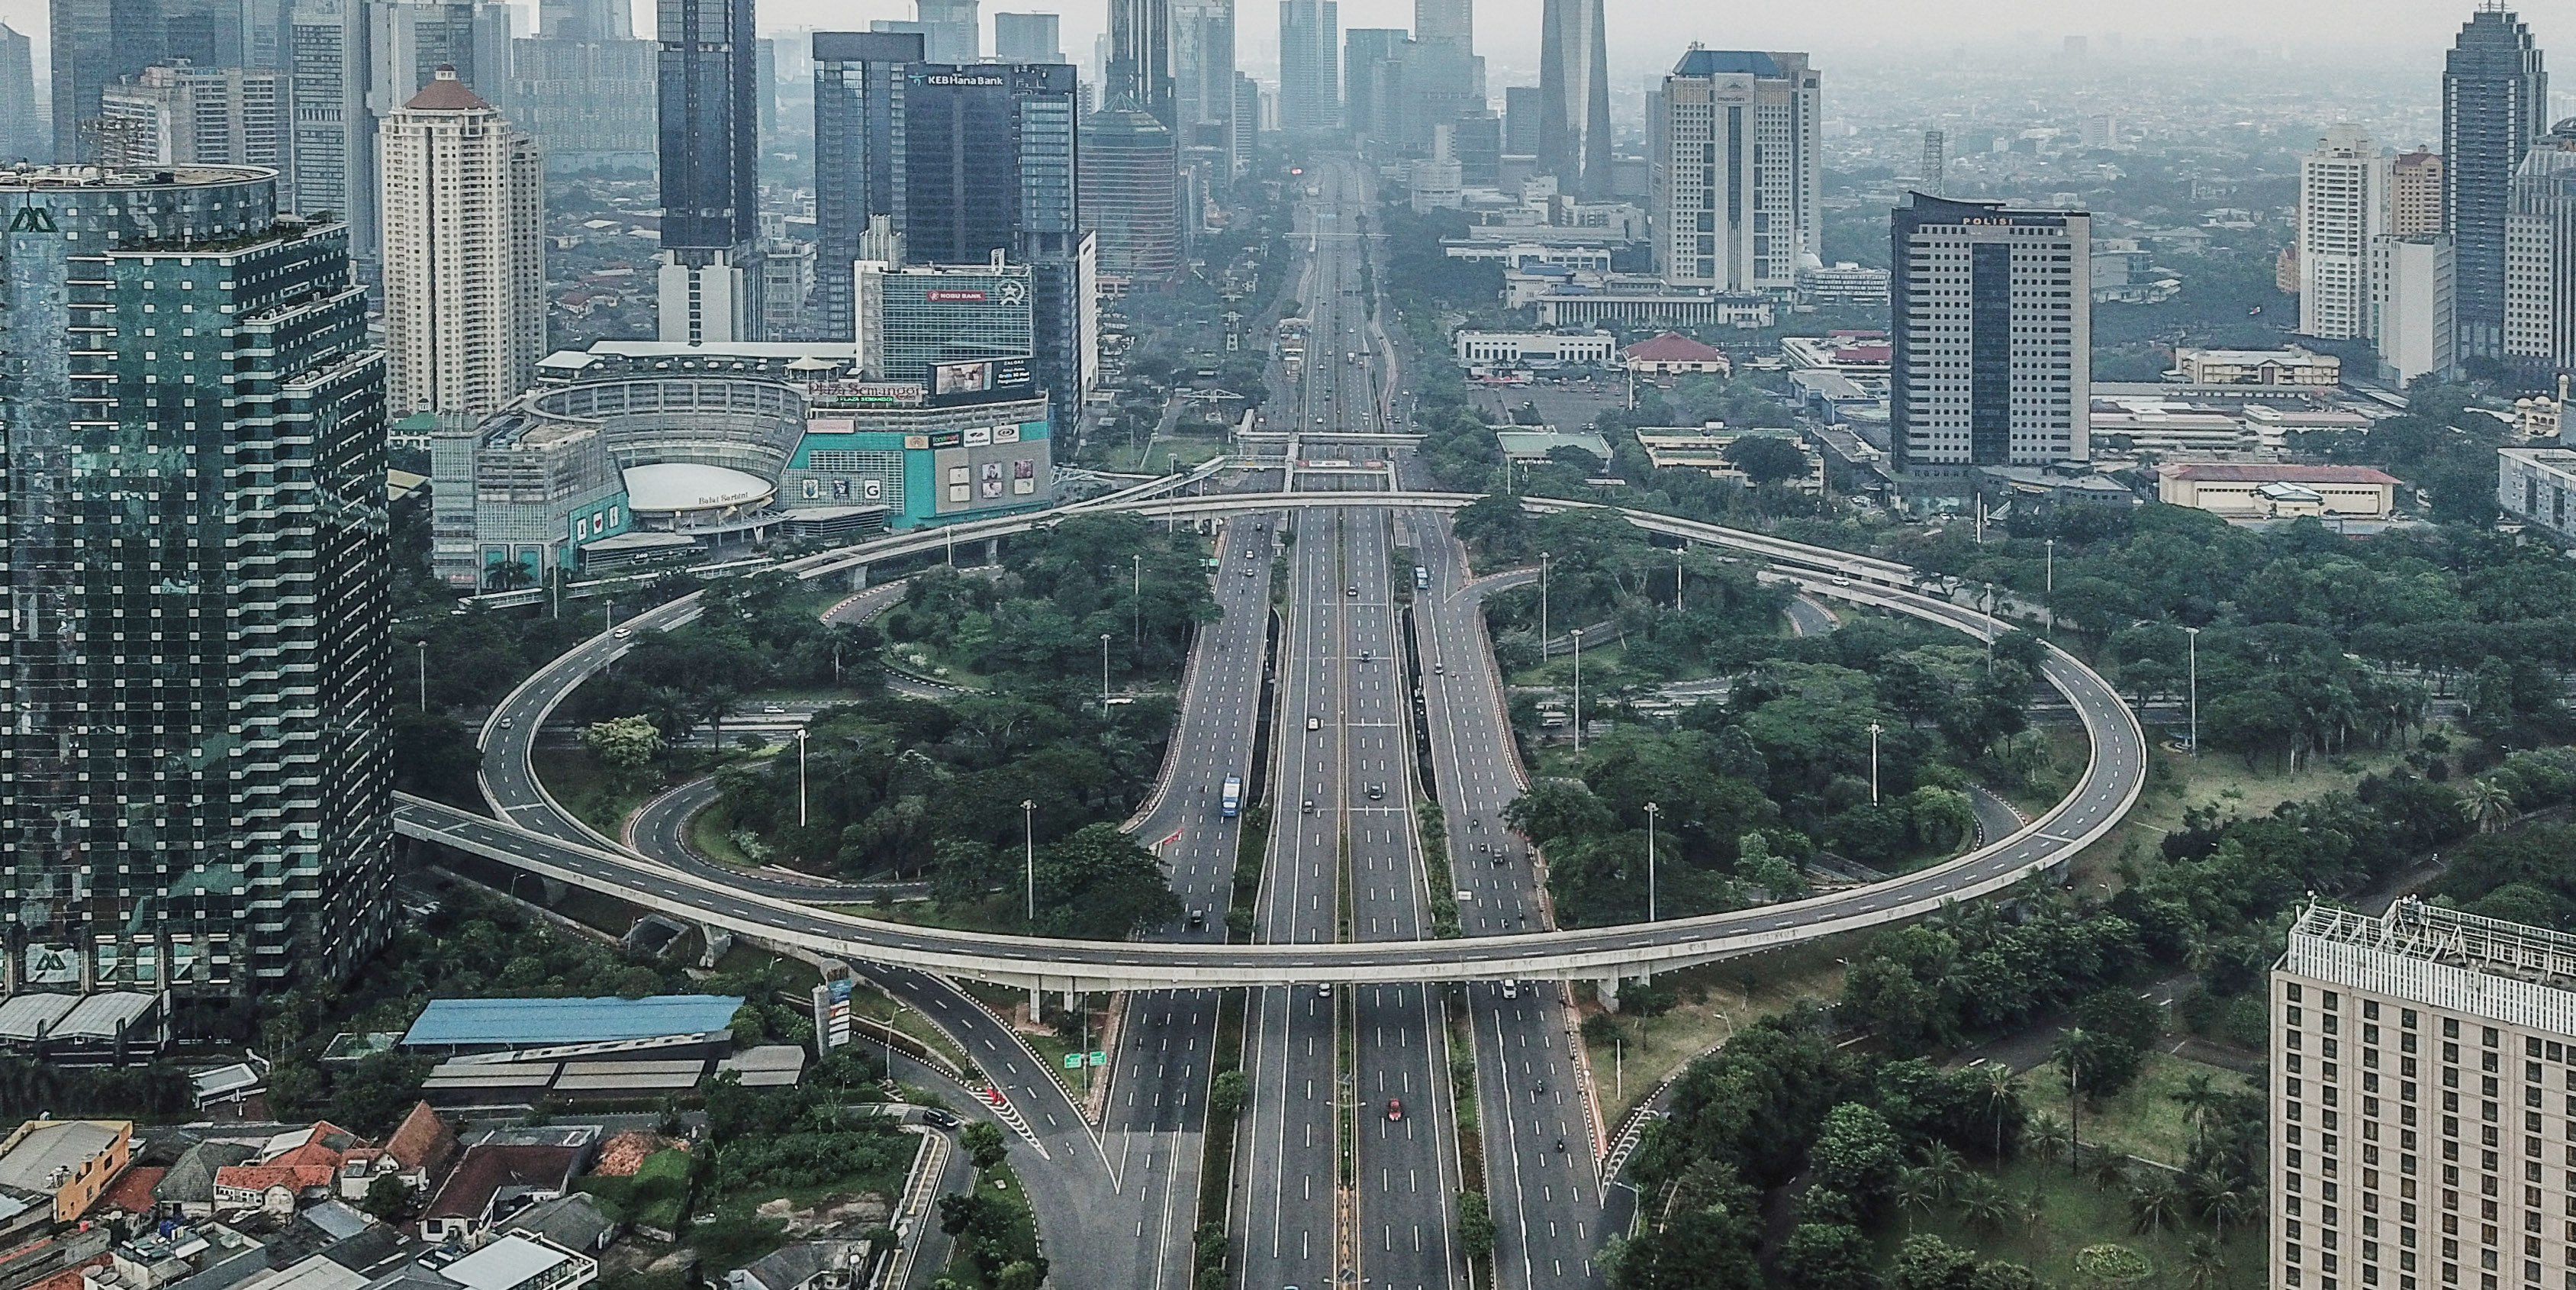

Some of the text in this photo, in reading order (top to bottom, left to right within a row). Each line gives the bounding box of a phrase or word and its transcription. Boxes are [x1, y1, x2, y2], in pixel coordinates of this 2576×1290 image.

[928, 76, 1003, 85] KEB Hana Bank
[808, 382, 920, 400] Plaza Semanggi
[866, 485, 879, 496] G
